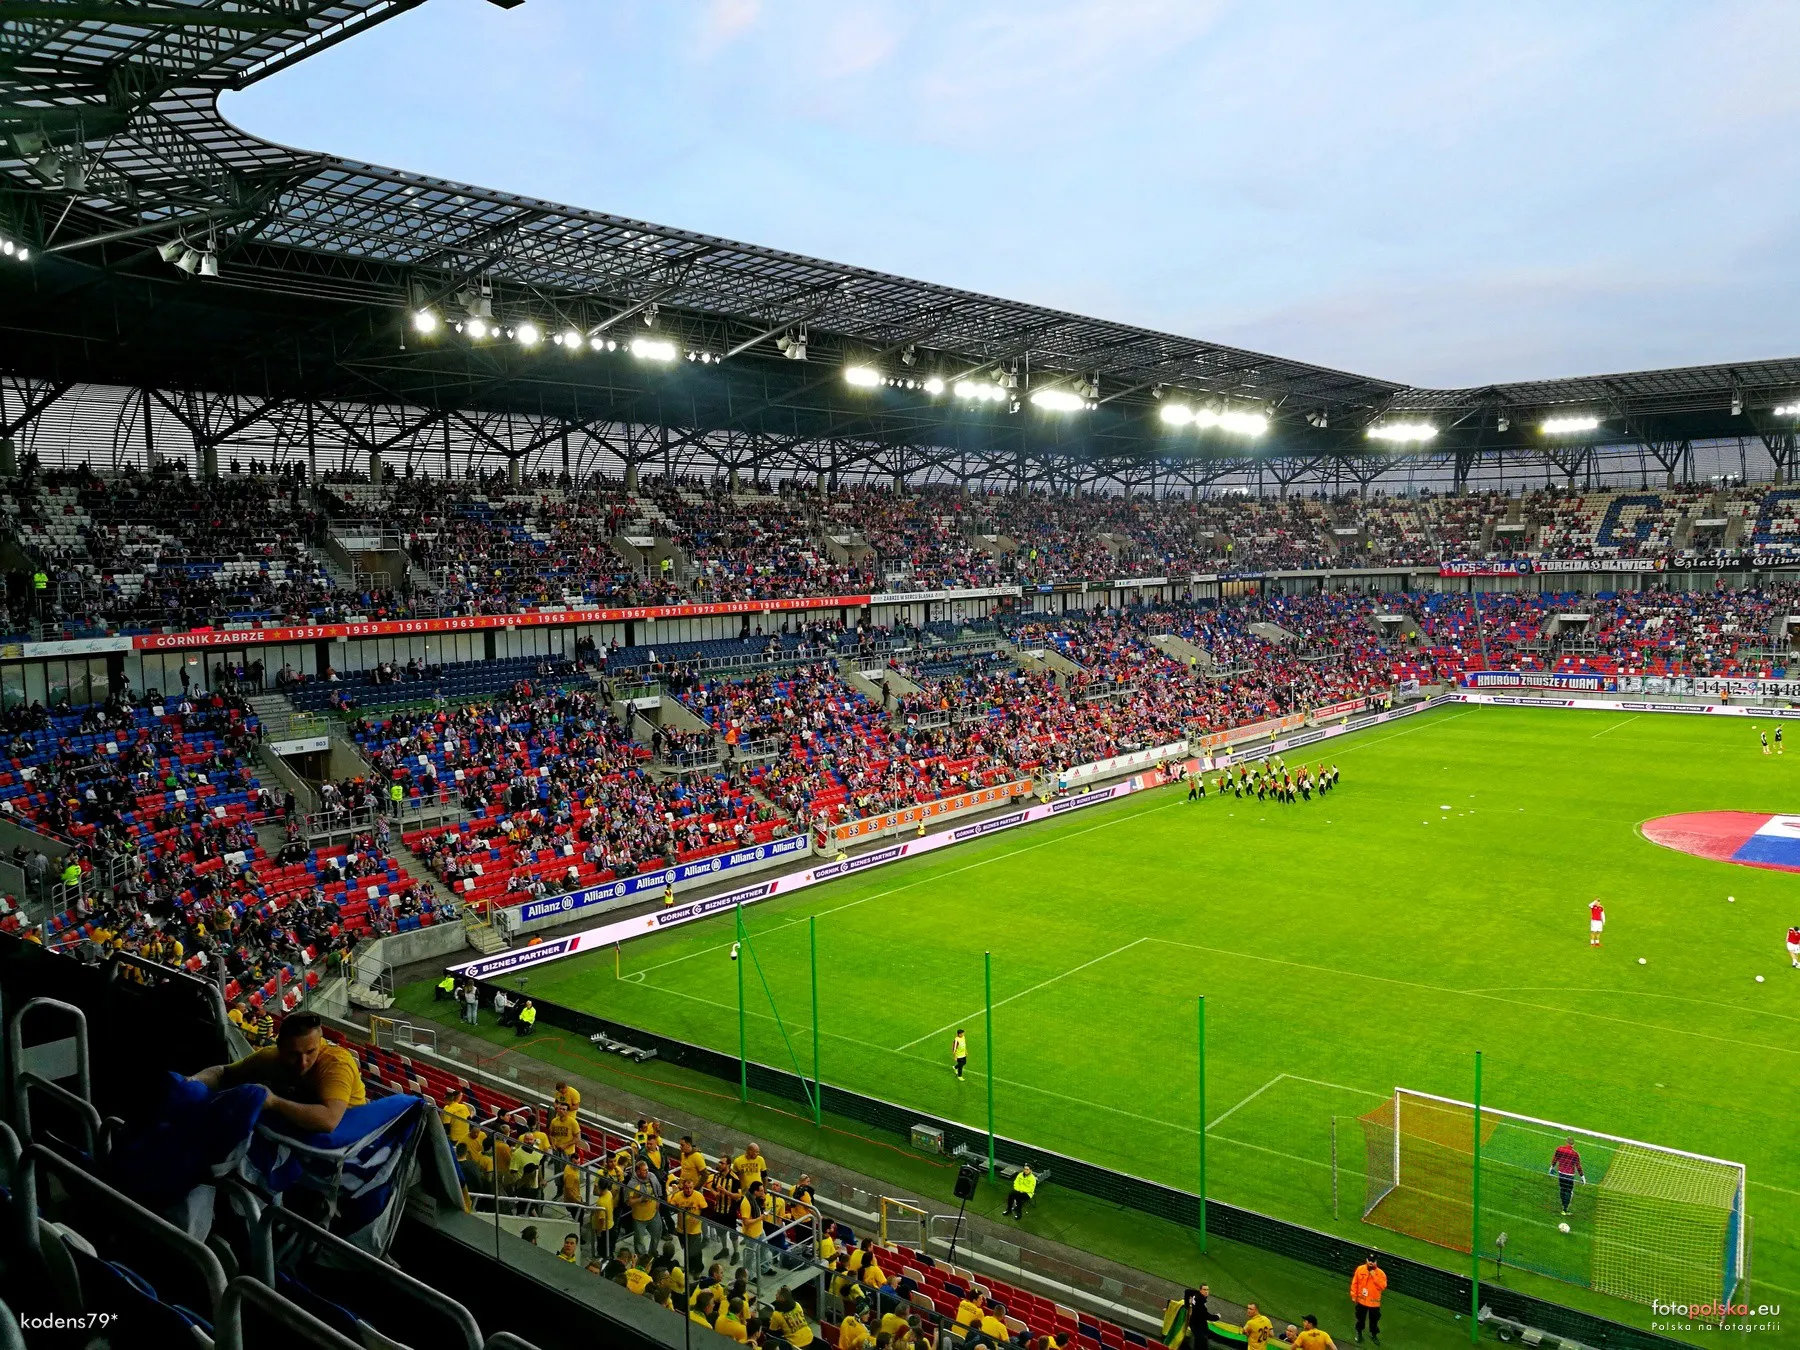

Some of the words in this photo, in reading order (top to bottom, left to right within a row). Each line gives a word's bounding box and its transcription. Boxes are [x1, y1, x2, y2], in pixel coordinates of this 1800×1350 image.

[1540, 561, 1590, 571] TORCIDA
[1601, 560, 1654, 571] GLIWICE
[1673, 557, 1740, 569] Szlachta
[1752, 556, 1800, 566] Gliwi
[157, 635, 210, 646] GÓRNIK
[214, 632, 264, 643] ZABRZE
[288, 628, 323, 638] 1957
[345, 625, 378, 635] 1959
[399, 622, 429, 631] 1961
[445, 619, 475, 629] 1963
[492, 616, 522, 626] 1964
[538, 614, 565, 623] 1965
[581, 611, 607, 620] 1966
[621, 609, 646, 618] 1967
[660, 607, 682, 616] 1971
[693, 605, 715, 613] 1972
[727, 603, 749, 611] 1985
[759, 601, 781, 609] 1986
[790, 600, 810, 608] 1987
[820, 598, 839, 606] 1988
[1477, 674, 1519, 686] KNURÓW
[1521, 676, 1560, 688] ZAWSZE
[1561, 678, 1567, 688] Z
[1569, 677, 1598, 690] WAMI
[772, 839, 796, 854] Allianz
[730, 850, 755, 866] Allianz
[850, 857, 870, 868] BIZNES
[872, 850, 897, 862] PARTNER
[684, 862, 711, 878] Allianz
[637, 874, 664, 890] Allianz
[584, 887, 613, 903] Allianz
[704, 897, 731, 910] BIZNES
[732, 888, 763, 902] PARTNER
[528, 901, 560, 918] Allianz
[482, 957, 517, 972] BIZNES
[519, 945, 560, 962] PARTNER
[1257, 1326, 1269, 1343] 26
